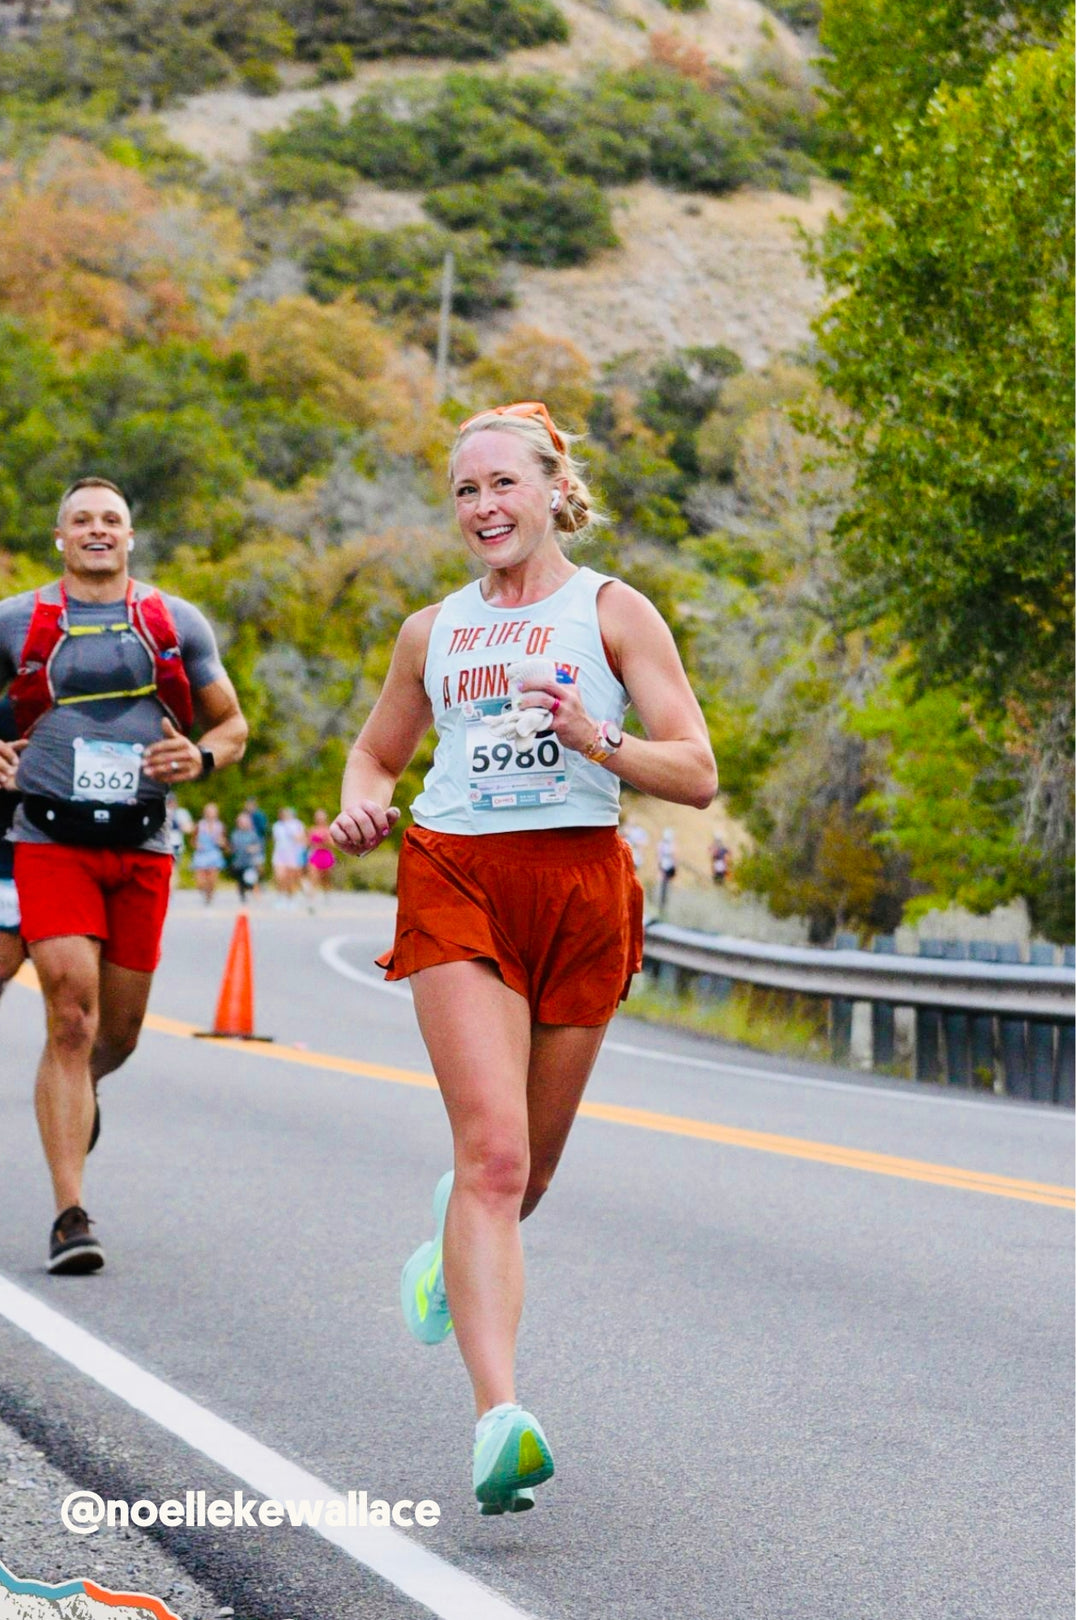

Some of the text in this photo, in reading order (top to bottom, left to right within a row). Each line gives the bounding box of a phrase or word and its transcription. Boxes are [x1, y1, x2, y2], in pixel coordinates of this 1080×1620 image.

[448, 620, 555, 656] THE LIFE OF
[443, 675, 452, 710] A
[472, 740, 559, 773] 5980
[77, 771, 134, 790] 6362
